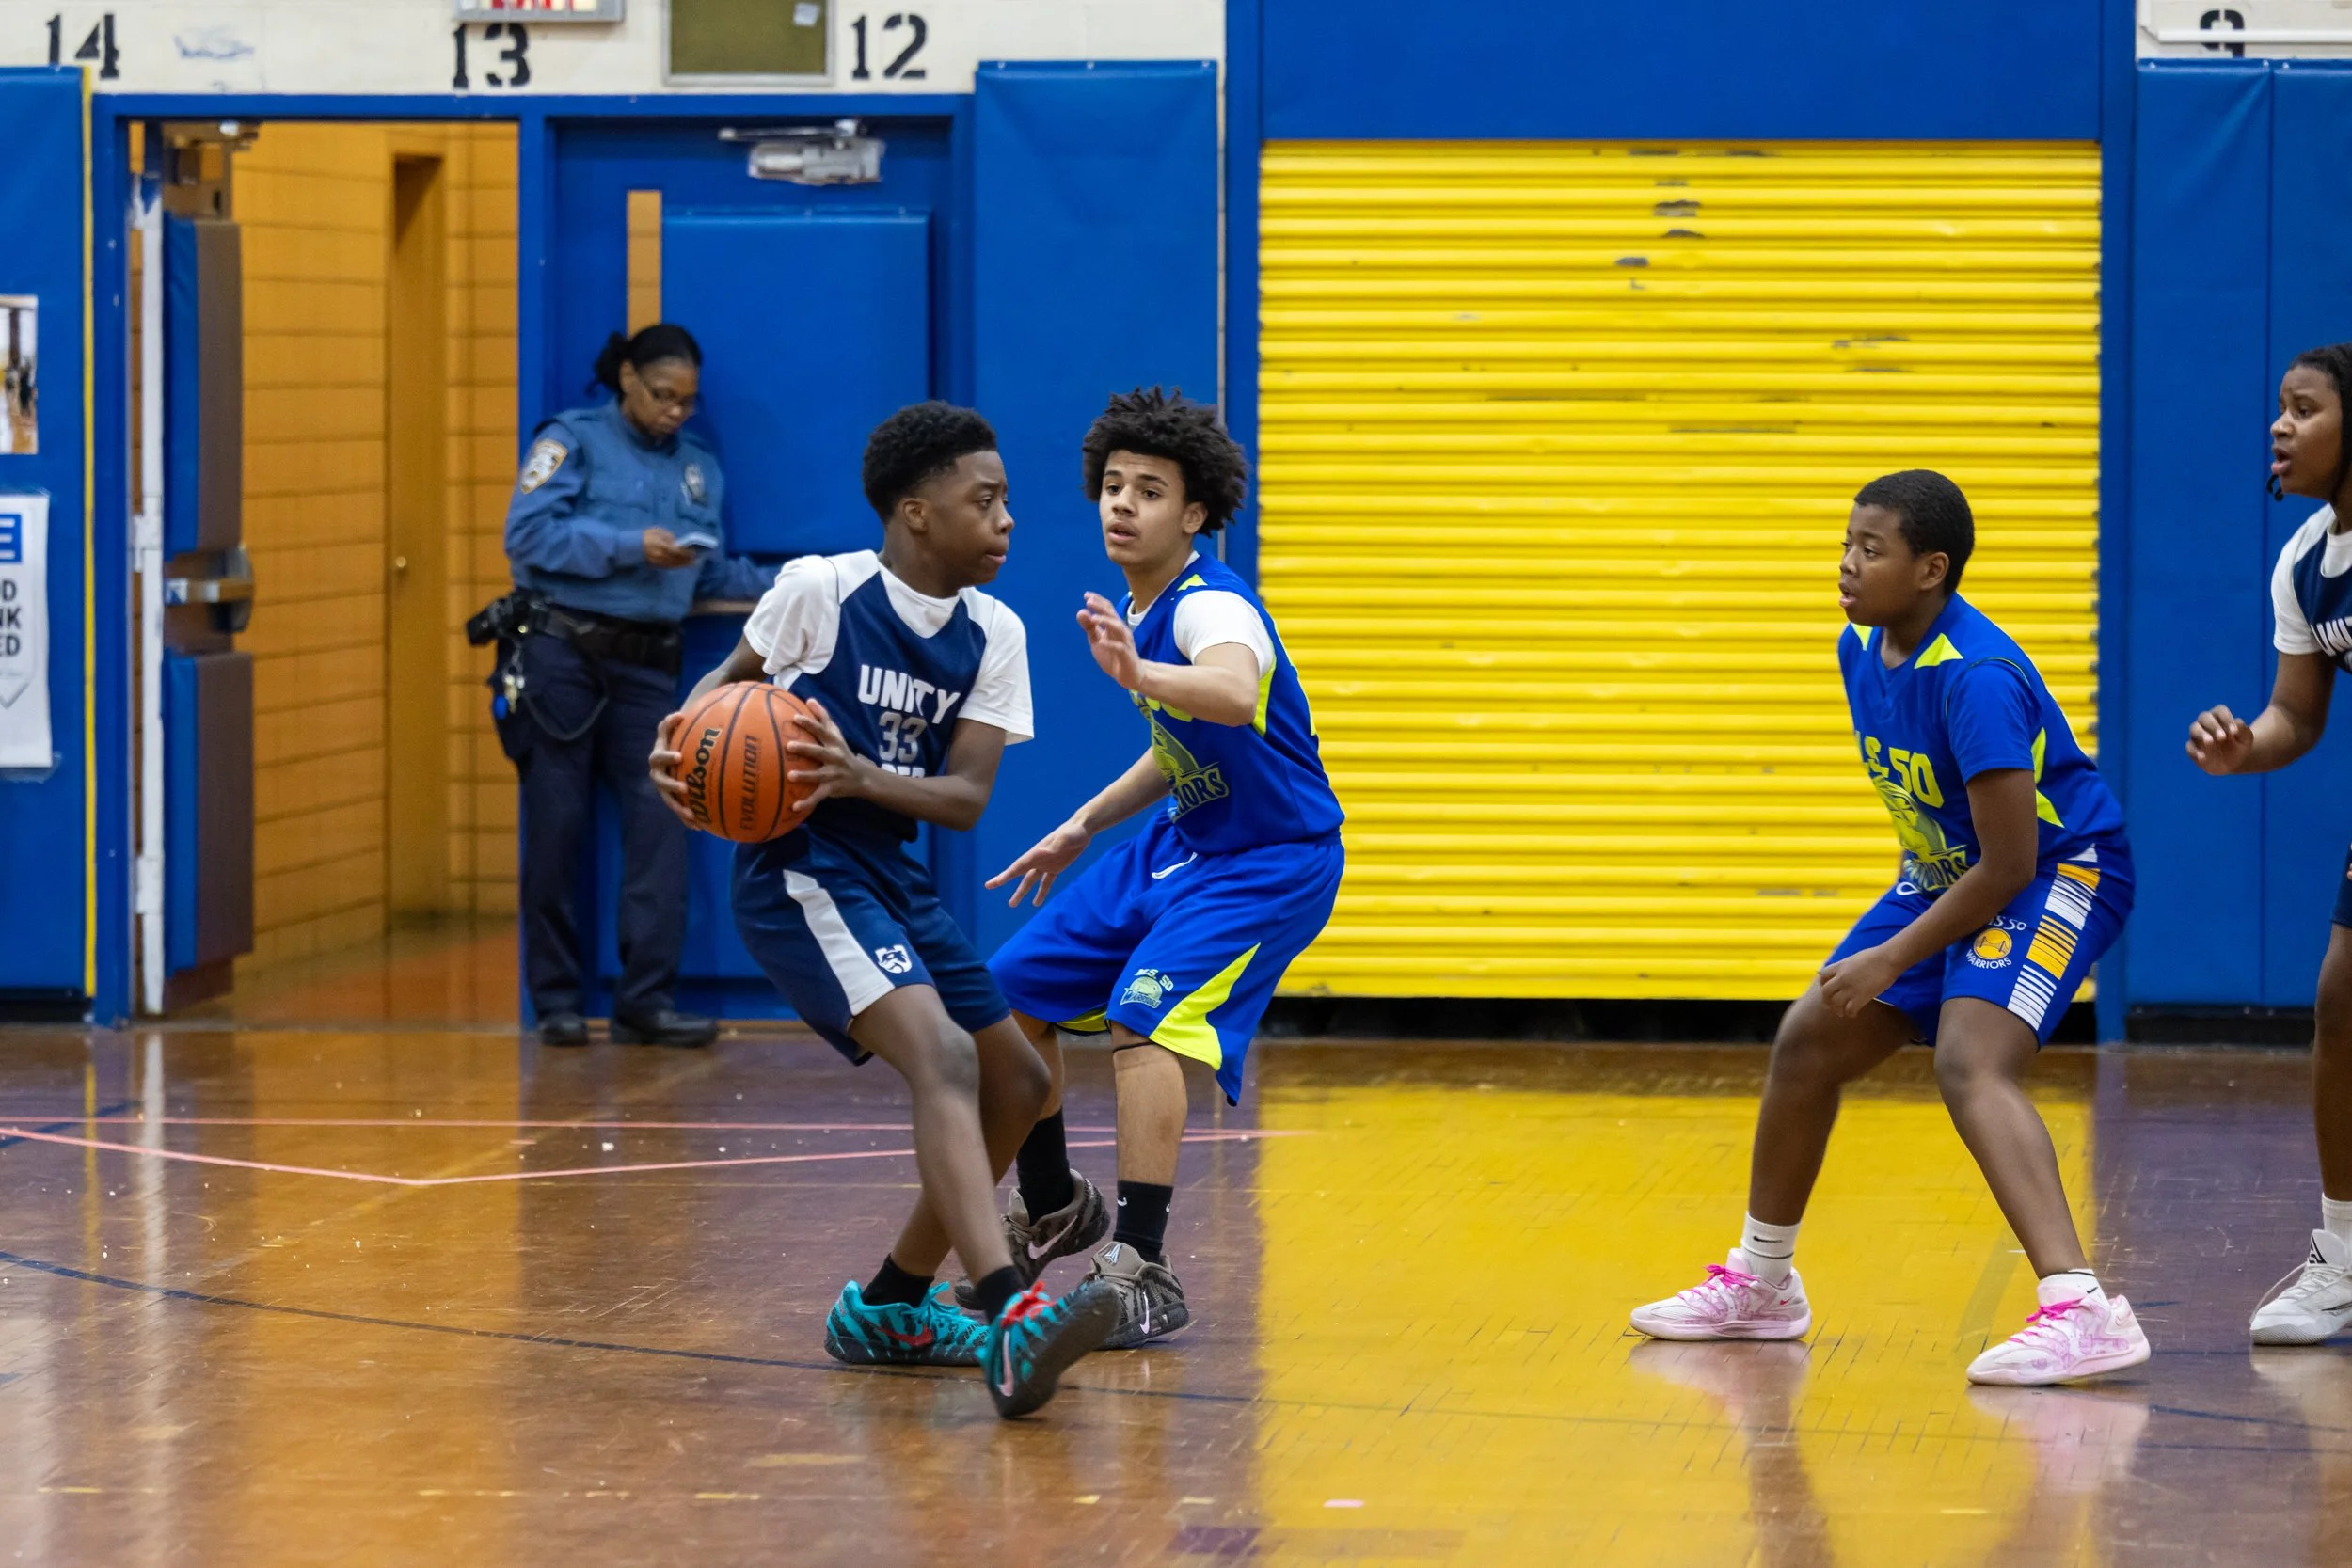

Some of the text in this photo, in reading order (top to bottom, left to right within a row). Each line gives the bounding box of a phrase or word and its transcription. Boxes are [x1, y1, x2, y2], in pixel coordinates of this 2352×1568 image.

[47, 14, 119, 79] 14
[453, 22, 531, 89] 13
[851, 13, 927, 80] 12
[858, 664, 961, 724] UNITY
[879, 711, 928, 763] 33
[685, 727, 723, 824] Wilson
[739, 734, 759, 831] EVOLUTION
[1889, 746, 1944, 809] 50
[1966, 949, 2011, 970] WARRIORS
